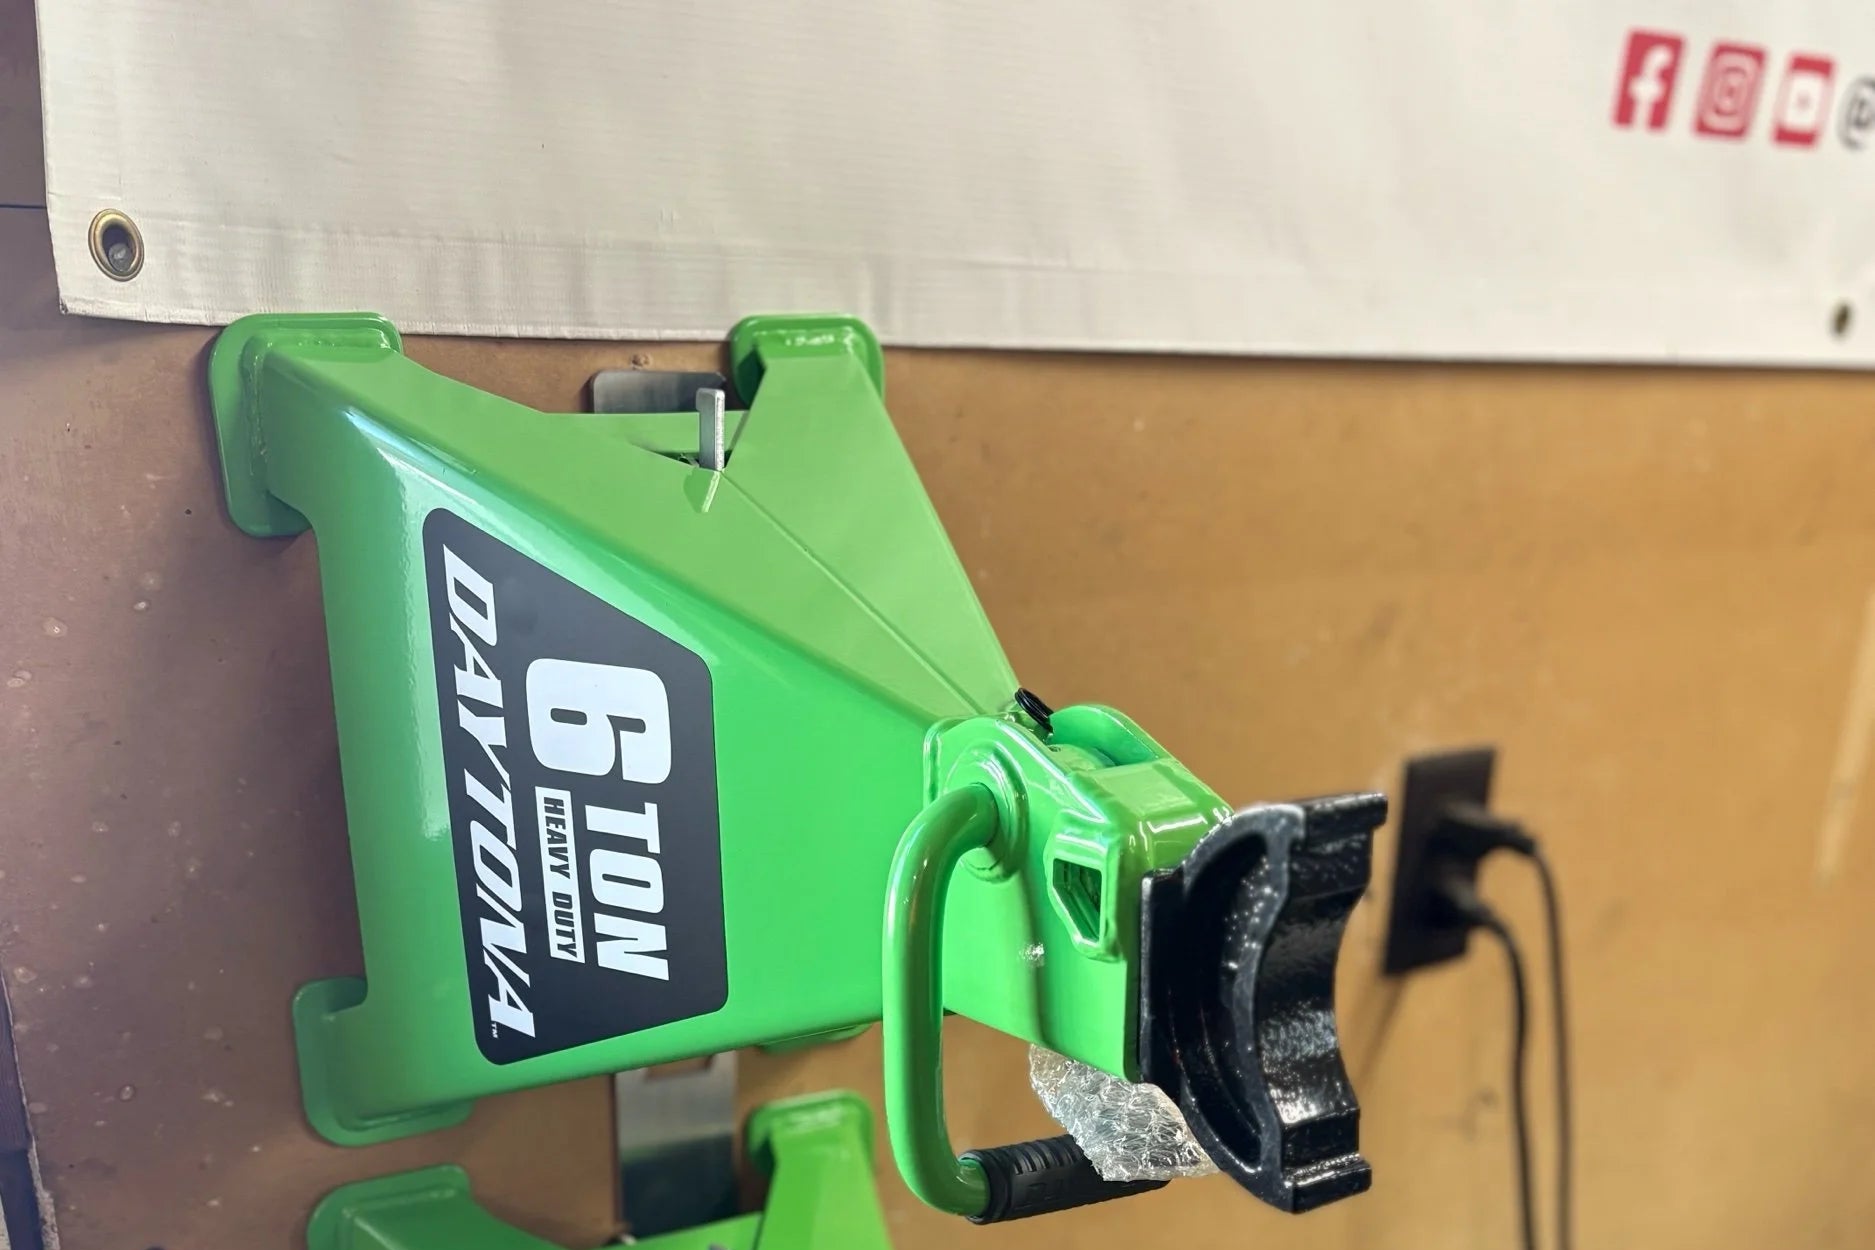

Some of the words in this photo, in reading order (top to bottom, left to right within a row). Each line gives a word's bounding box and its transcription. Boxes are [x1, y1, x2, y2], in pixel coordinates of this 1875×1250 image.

[526, 658, 671, 785] 6
[443, 544, 536, 1038] DAYTONA
[543, 796, 571, 879] HEAVY
[552, 891, 578, 958] DUTY
[585, 802, 670, 981] TON
